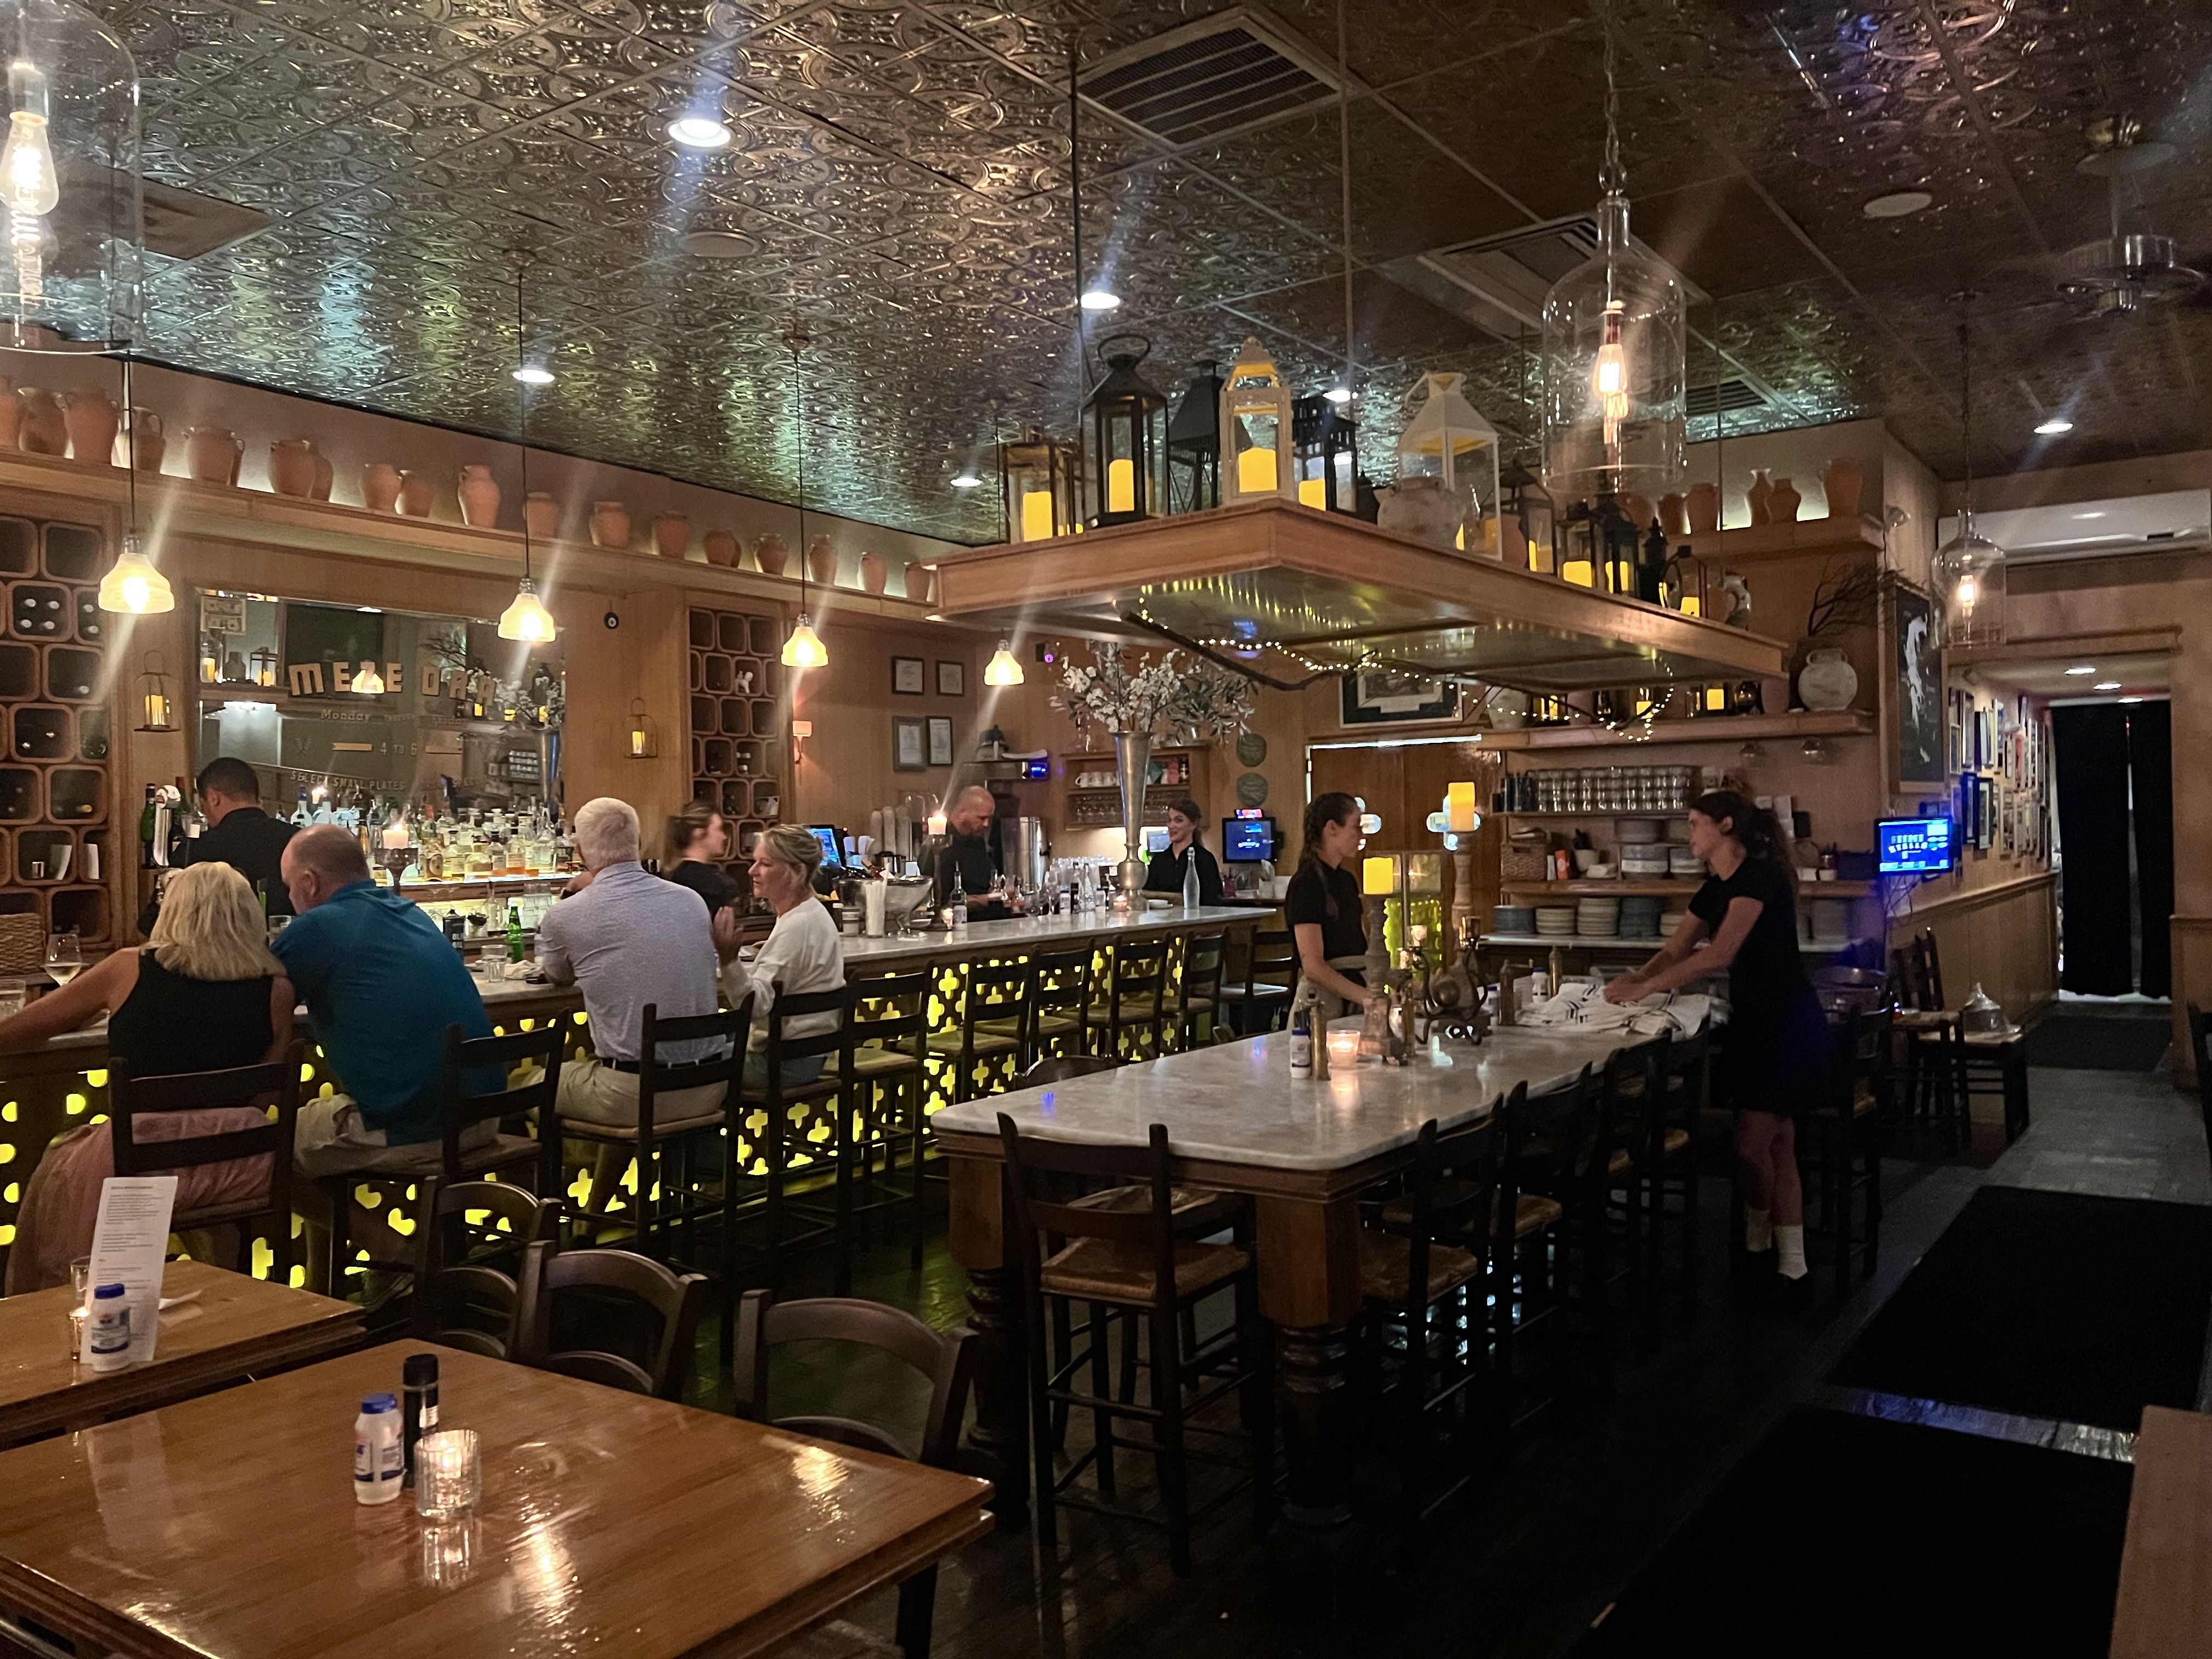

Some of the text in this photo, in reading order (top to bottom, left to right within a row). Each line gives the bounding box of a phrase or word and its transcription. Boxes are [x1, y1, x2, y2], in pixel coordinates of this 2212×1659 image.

[289, 662, 402, 696] MEZE
[320, 709, 371, 724] Monday
[380, 742, 387, 755] 4
[411, 743, 418, 756] 6
[369, 780, 406, 791] PLATES
